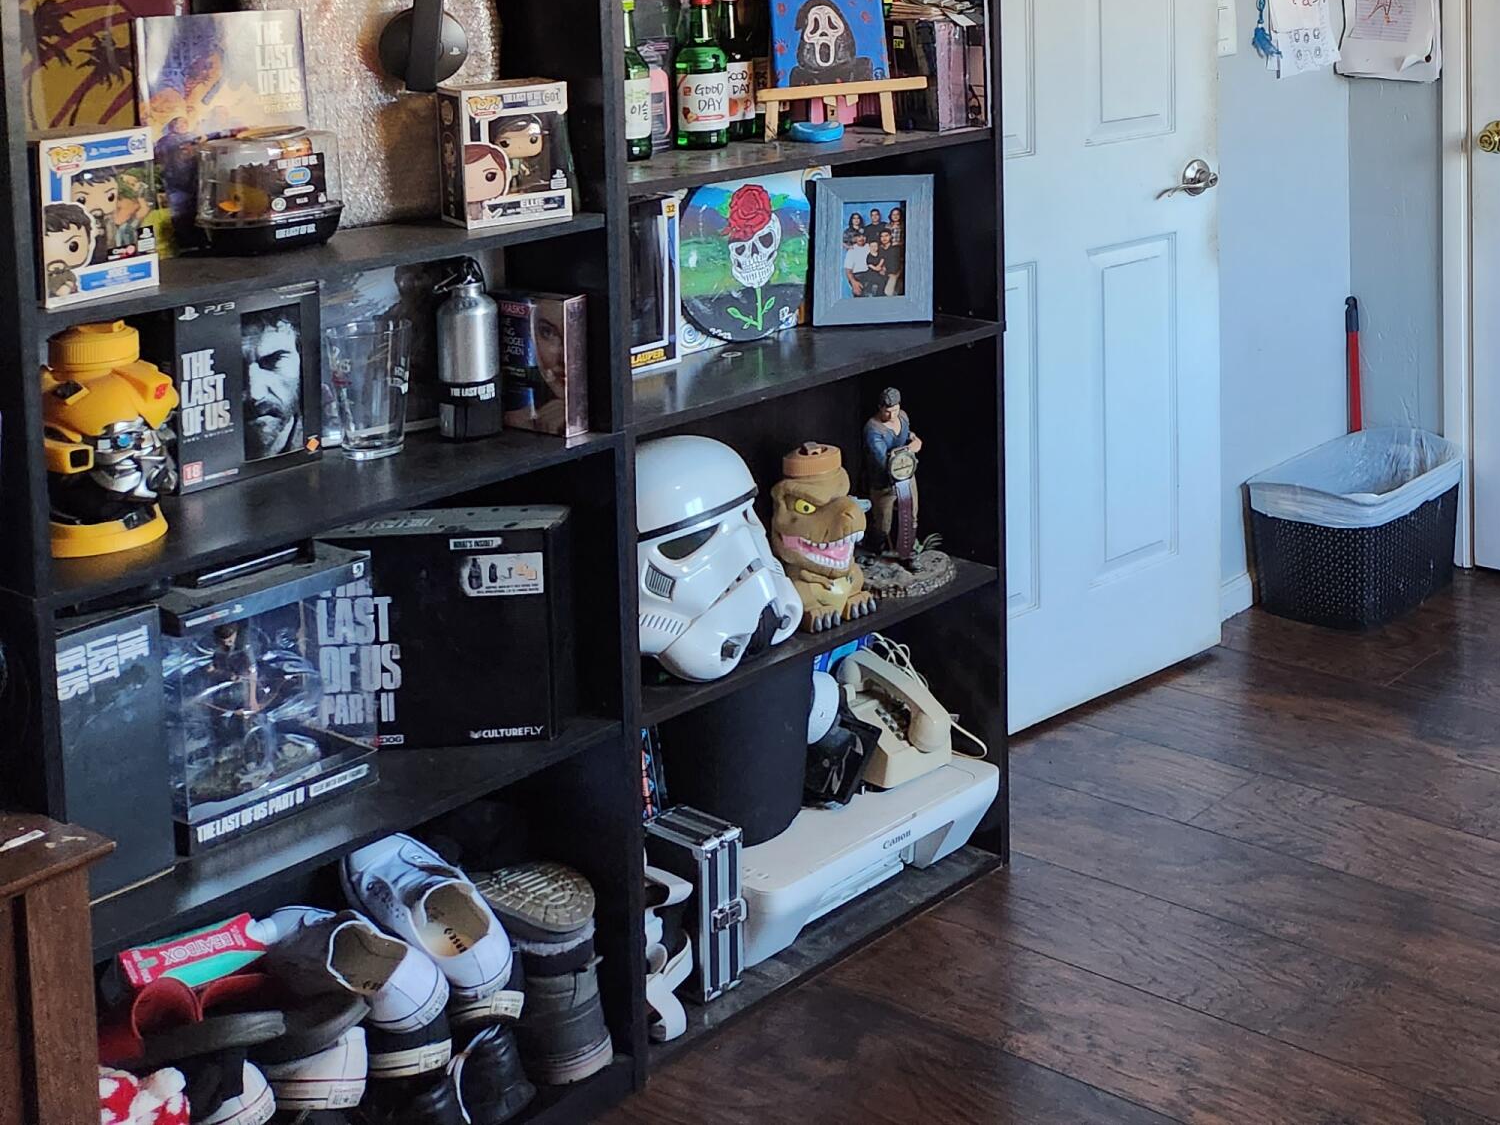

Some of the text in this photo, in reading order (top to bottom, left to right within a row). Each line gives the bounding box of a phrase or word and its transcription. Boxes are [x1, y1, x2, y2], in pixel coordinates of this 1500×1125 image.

[256, 20, 282, 45] THE
[255, 44, 295, 70] LAST
[256, 68, 301, 95] OF US
[694, 82, 724, 96] GOOD
[697, 97, 723, 112] DAY
[204, 301, 236, 315] PS3
[181, 349, 215, 381] THE
[181, 374, 226, 409] LAST
[182, 400, 232, 437] OF US
[185, 465, 200, 480] 18
[316, 596, 393, 646] LAST
[86, 634, 121, 684] LAST
[117, 625, 150, 664] THE
[55, 645, 90, 701] OF US
[318, 643, 402, 694] OF US
[320, 692, 376, 728] PART
[482, 725, 544, 739] CULTUREFLY
[196, 820, 217, 844] THE
[216, 811, 241, 836] LAST
[240, 807, 253, 826] OF
[253, 801, 269, 821] US
[268, 790, 296, 816] PART
[882, 829, 912, 850] Canon
[160, 931, 235, 966] BEATBOX
